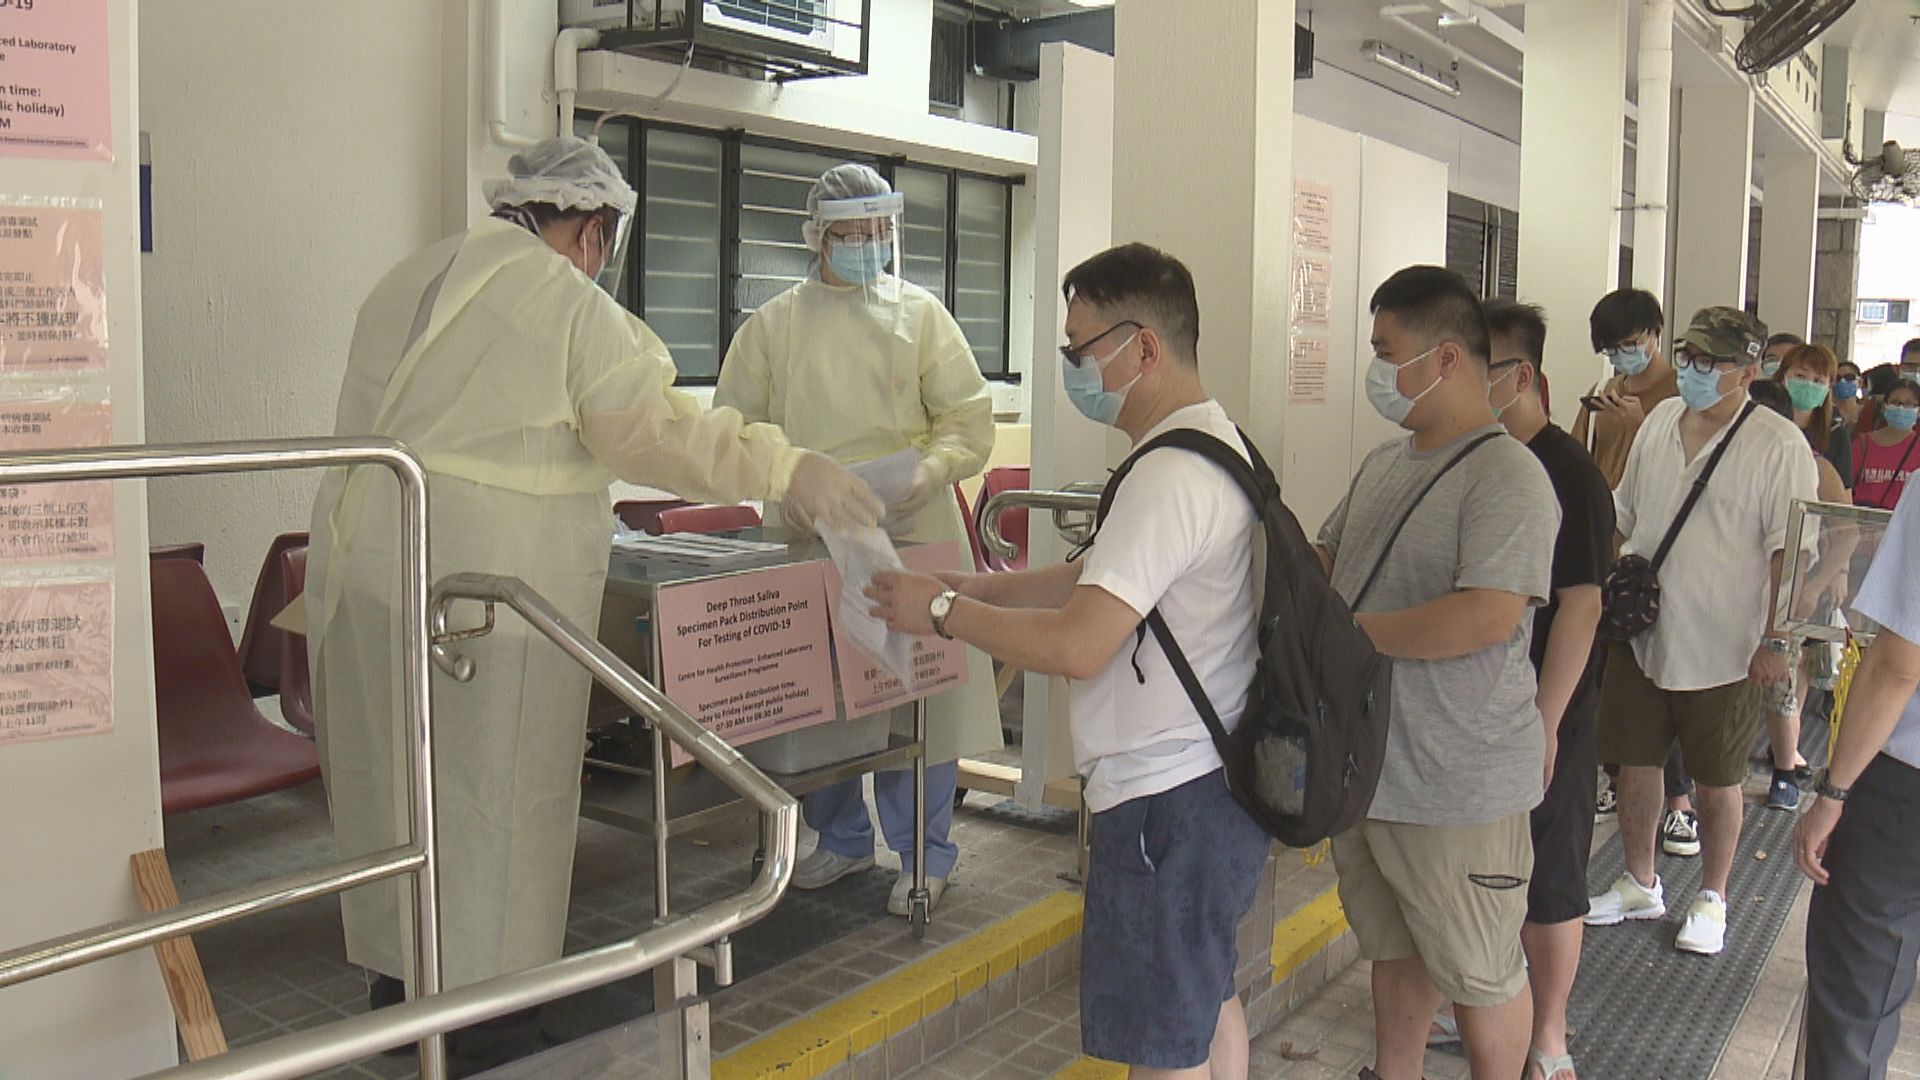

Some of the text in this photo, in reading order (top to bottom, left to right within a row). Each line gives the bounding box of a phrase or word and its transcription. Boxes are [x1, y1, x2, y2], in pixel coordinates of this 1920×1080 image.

[19, 37, 76, 54] Laboratory
[10, 84, 41, 97] time:
[17, 102, 64, 117] holiday)
[707, 590, 780, 613] Deep Throat Saliva
[677, 600, 808, 636] Specimen Pack Distribution Point
[698, 618, 791, 648] For Testing of COVID-19
[678, 673, 696, 682] Centre
[697, 669, 705, 677] for
[707, 664, 724, 674] Health
[726, 657, 753, 670] Protection
[758, 649, 783, 661] Enhanced
[784, 644, 812, 655] Laboratory
[715, 662, 779, 683] Surveillance Programme
[699, 681, 797, 712] Specimen pack distribution time:
[714, 711, 721, 719] to
[722, 706, 741, 718] Friday
[742, 699, 765, 712] (except
[765, 696, 784, 706] public
[785, 688, 809, 700] holiday)
[715, 721, 733, 731] 07:30
[734, 717, 745, 726] AM
[746, 715, 753, 723] to
[773, 706, 784, 716] AM
